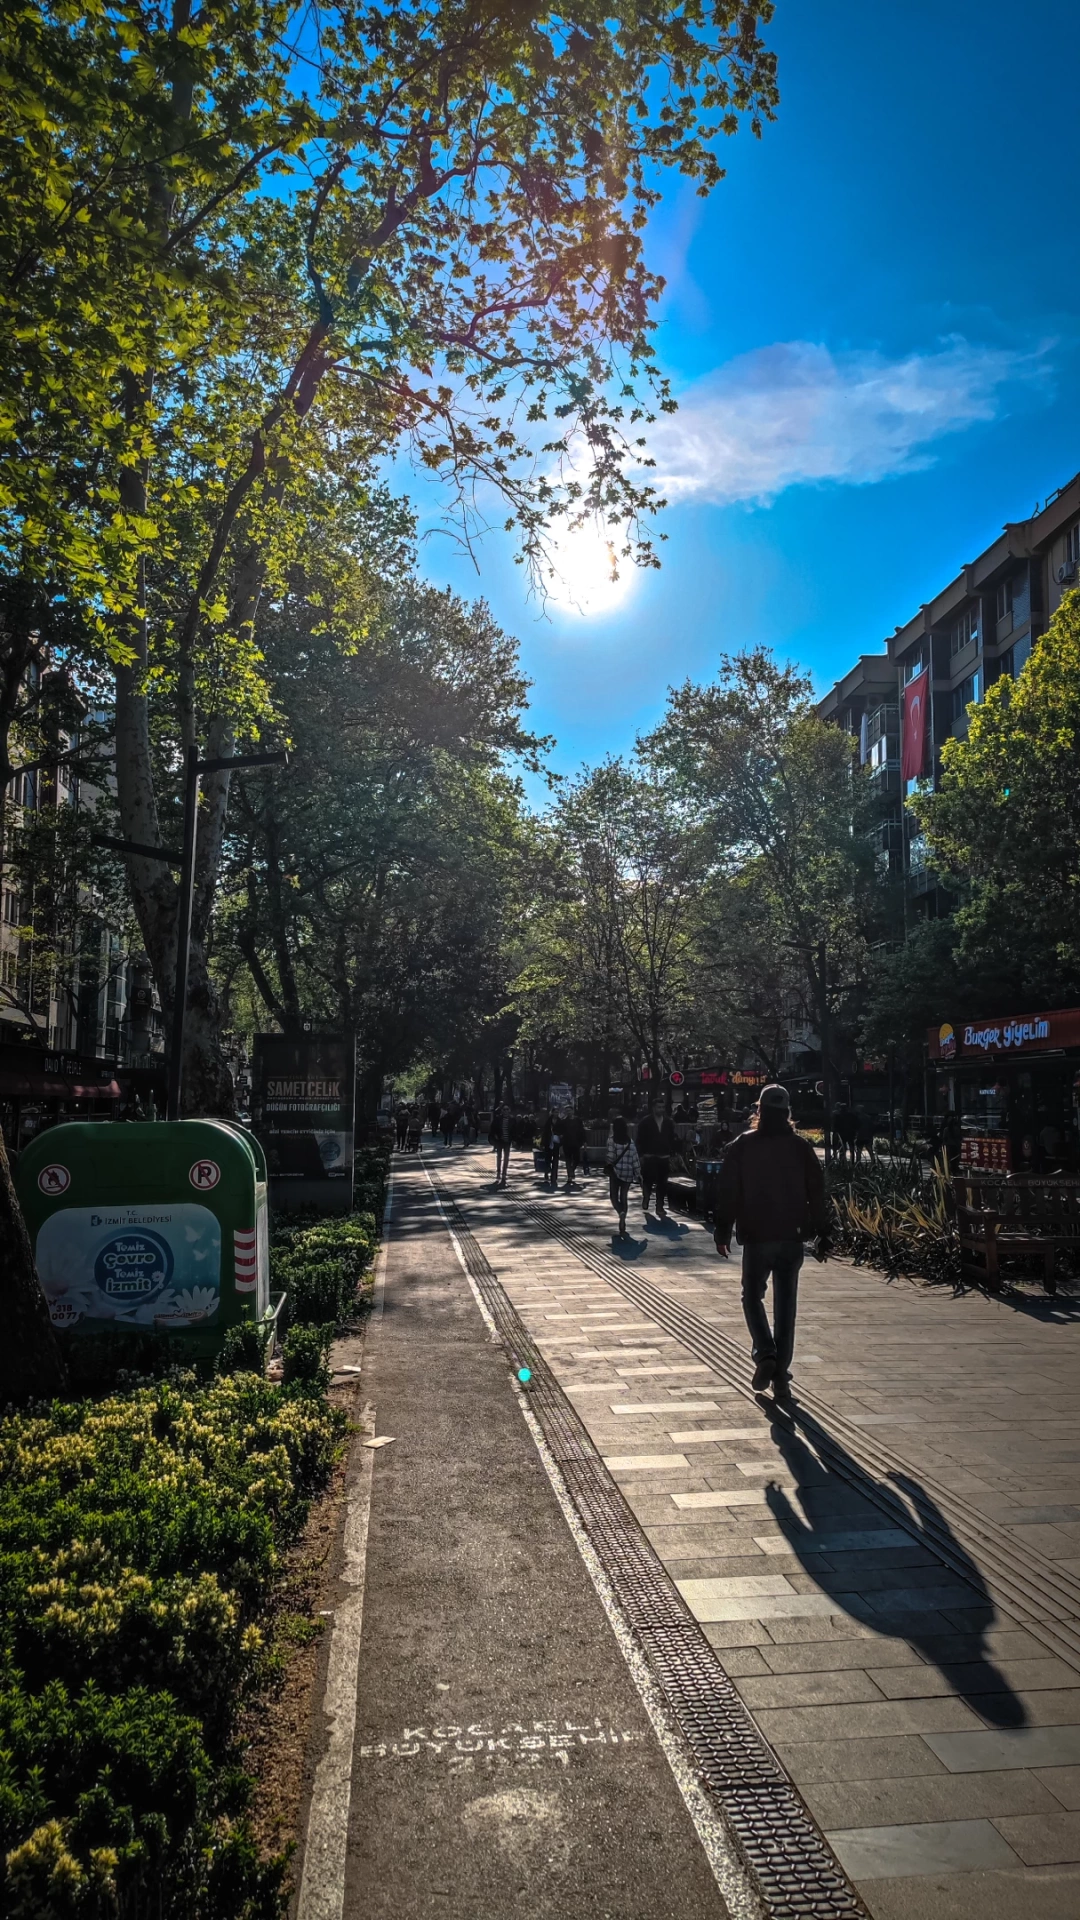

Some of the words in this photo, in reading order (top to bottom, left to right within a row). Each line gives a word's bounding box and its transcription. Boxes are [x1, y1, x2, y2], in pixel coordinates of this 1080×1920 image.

[267, 1081, 306, 1097] SAMET
[266, 1102, 288, 1112] DÜĞÜN
[288, 1102, 341, 1113] FOTOĞRAFÇILIĞI
[104, 1217, 127, 1225] İZMİT
[128, 1214, 172, 1224] BELEDİYESİ
[114, 1240, 146, 1252] Temiz
[103, 1252, 157, 1270] Çevre
[114, 1267, 145, 1279] Temiz
[56, 1304, 73, 1312] 318
[66, 1311, 78, 1320] 77
